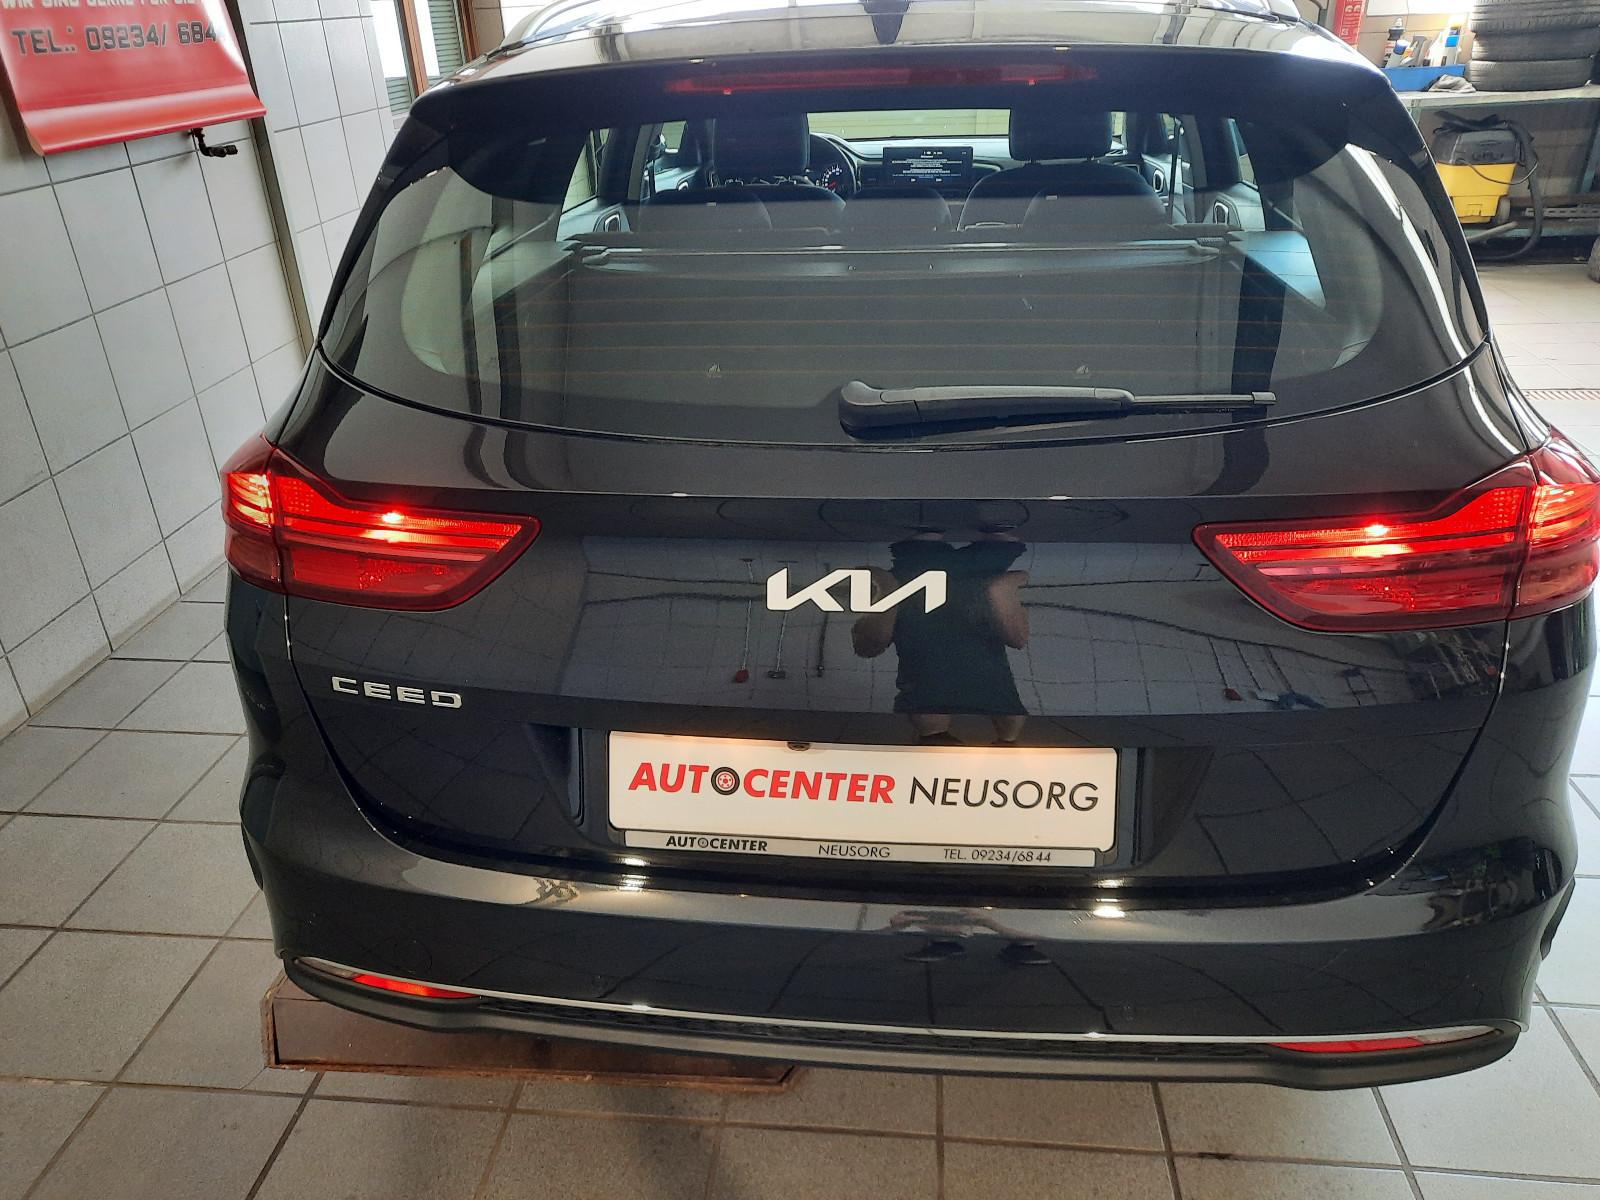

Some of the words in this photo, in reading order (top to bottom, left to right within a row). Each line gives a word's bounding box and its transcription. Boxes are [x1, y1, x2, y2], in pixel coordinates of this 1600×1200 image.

[85, 23, 168, 51] 09234/
[331, 676, 464, 709] CEED
[628, 762, 896, 804] AUTOCENTER
[909, 776, 1099, 811] NEUSORG
[665, 835, 768, 851] AUTOCENTER
[818, 844, 890, 858] NEUSORG
[943, 848, 967, 860] TEL.
